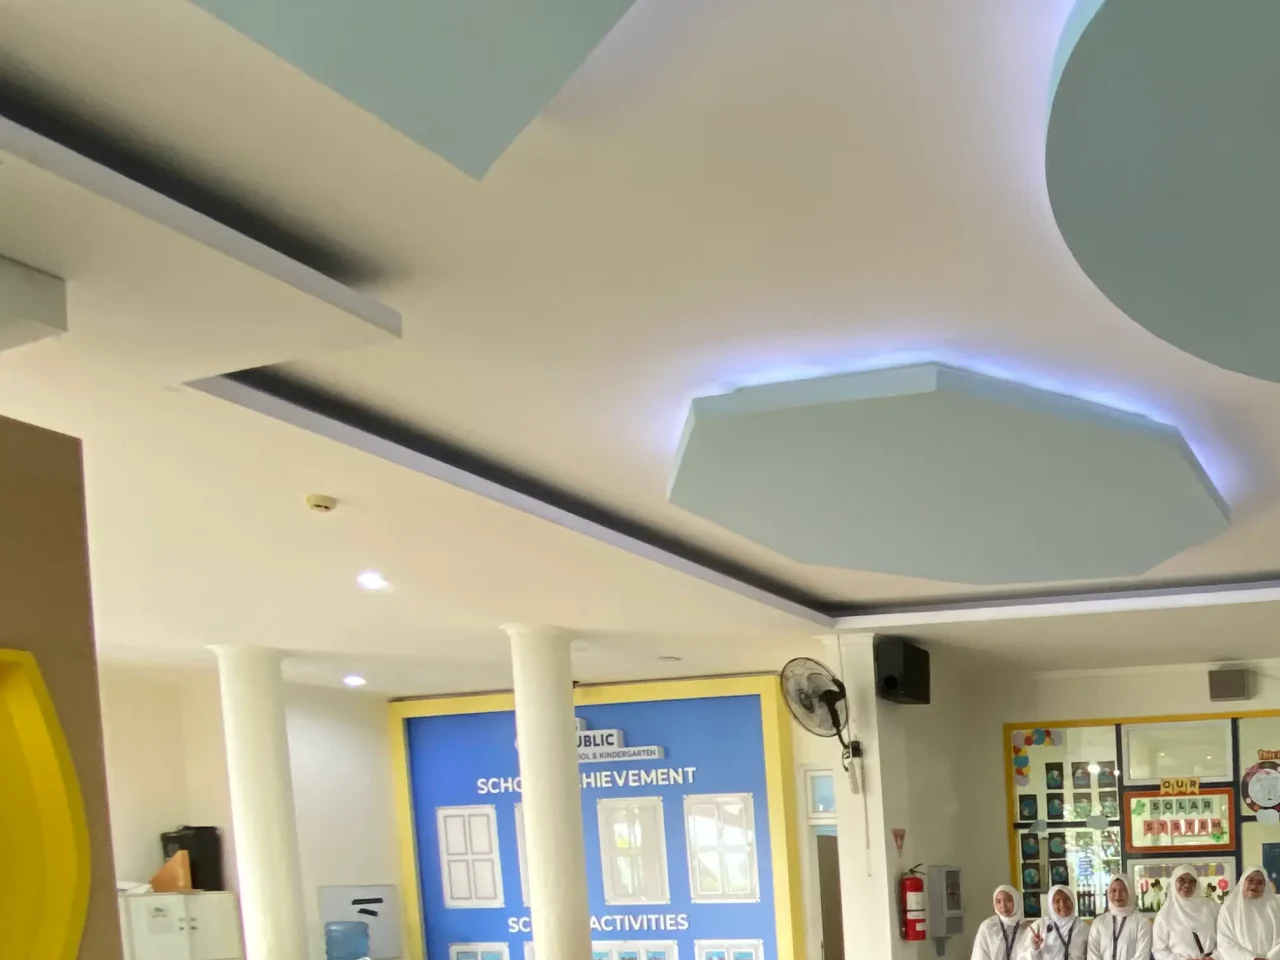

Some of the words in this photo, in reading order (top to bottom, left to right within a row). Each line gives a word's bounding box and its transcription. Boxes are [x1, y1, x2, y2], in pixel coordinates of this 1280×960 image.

[577, 733, 615, 748] UBLIC
[599, 749, 656, 760] KINDERGARTEN
[477, 777, 522, 794] SCHO
[578, 767, 697, 789] HIEVEMENT
[1162, 780, 1197, 789] OUR
[1152, 801, 1212, 811] SOLAR
[1146, 821, 1221, 832] SYSTEM
[589, 914, 689, 932] ACTIVITIES
